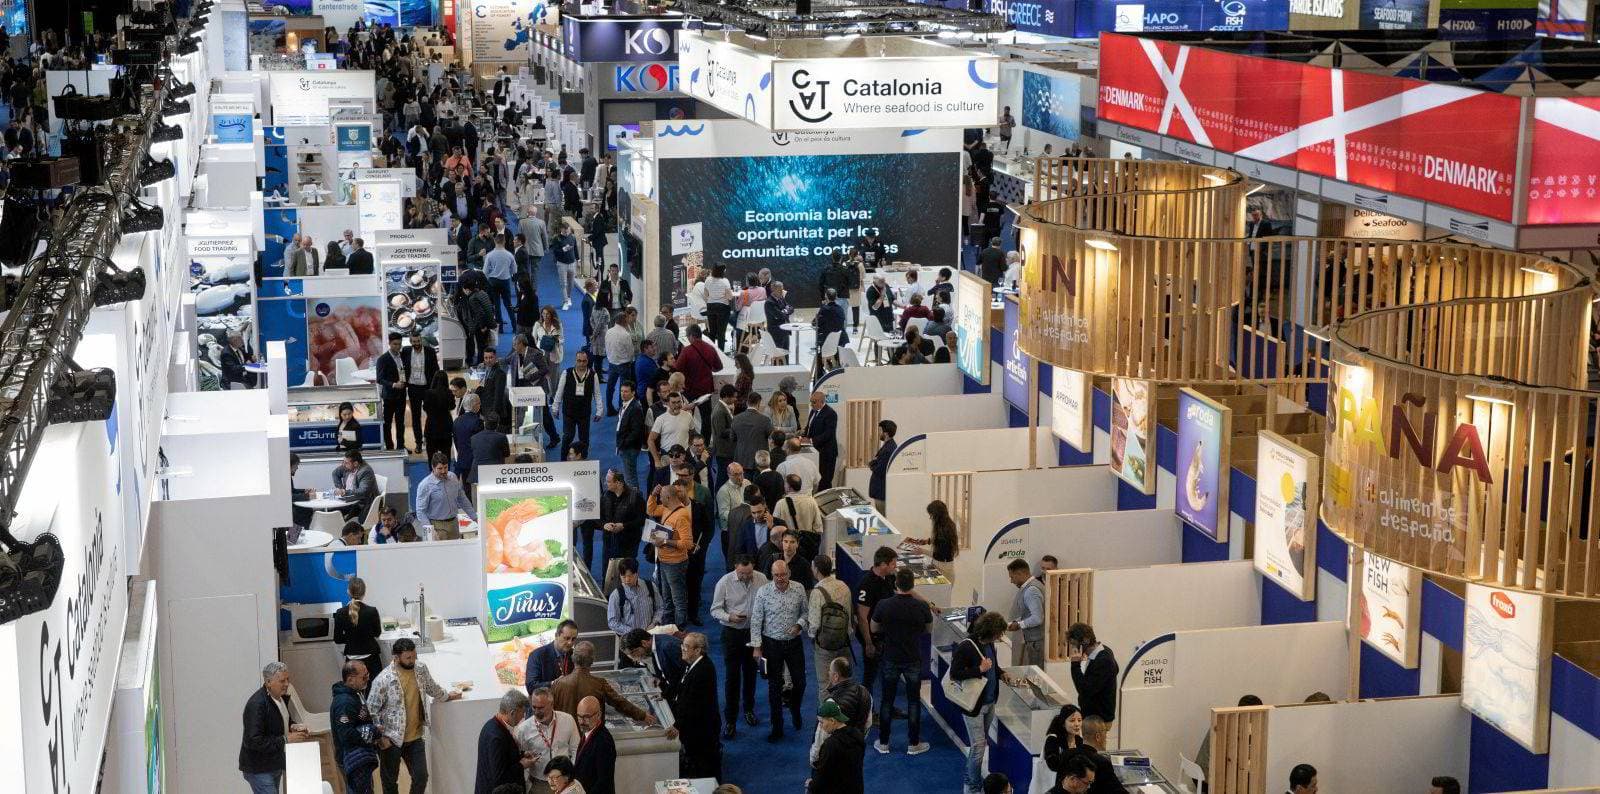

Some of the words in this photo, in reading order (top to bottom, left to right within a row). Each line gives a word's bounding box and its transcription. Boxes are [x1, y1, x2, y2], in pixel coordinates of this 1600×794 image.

[1010, 2, 1042, 26] GREECE
[1144, 13, 1179, 24] HAPO
[1374, 8, 1396, 20] SEAFOOD
[1452, 20, 1476, 31] H700
[1497, 20, 1523, 30] H100
[843, 78, 942, 97] Catalonia
[1105, 86, 1145, 111] DENMARK
[843, 102, 882, 113] Where
[885, 102, 930, 113] seafood
[934, 102, 943, 111] is
[947, 100, 984, 111] culture
[1424, 155, 1497, 194] DENMARK
[745, 210, 823, 223] Economia
[827, 208, 873, 220] blava:
[1372, 219, 1408, 227] Seafood
[737, 226, 824, 241] oportunitat
[828, 228, 854, 240] per
[722, 245, 809, 259] comunitats
[501, 466, 549, 476] COCEDERO
[496, 477, 507, 485] DE
[509, 475, 554, 484] MARISCOS
[1369, 553, 1391, 575] NEW
[1367, 567, 1389, 595] FISH
[66, 506, 104, 681] Catalonia
[858, 589, 867, 602] 2
[1144, 668, 1163, 676] NEW
[1144, 676, 1162, 684] FISH
